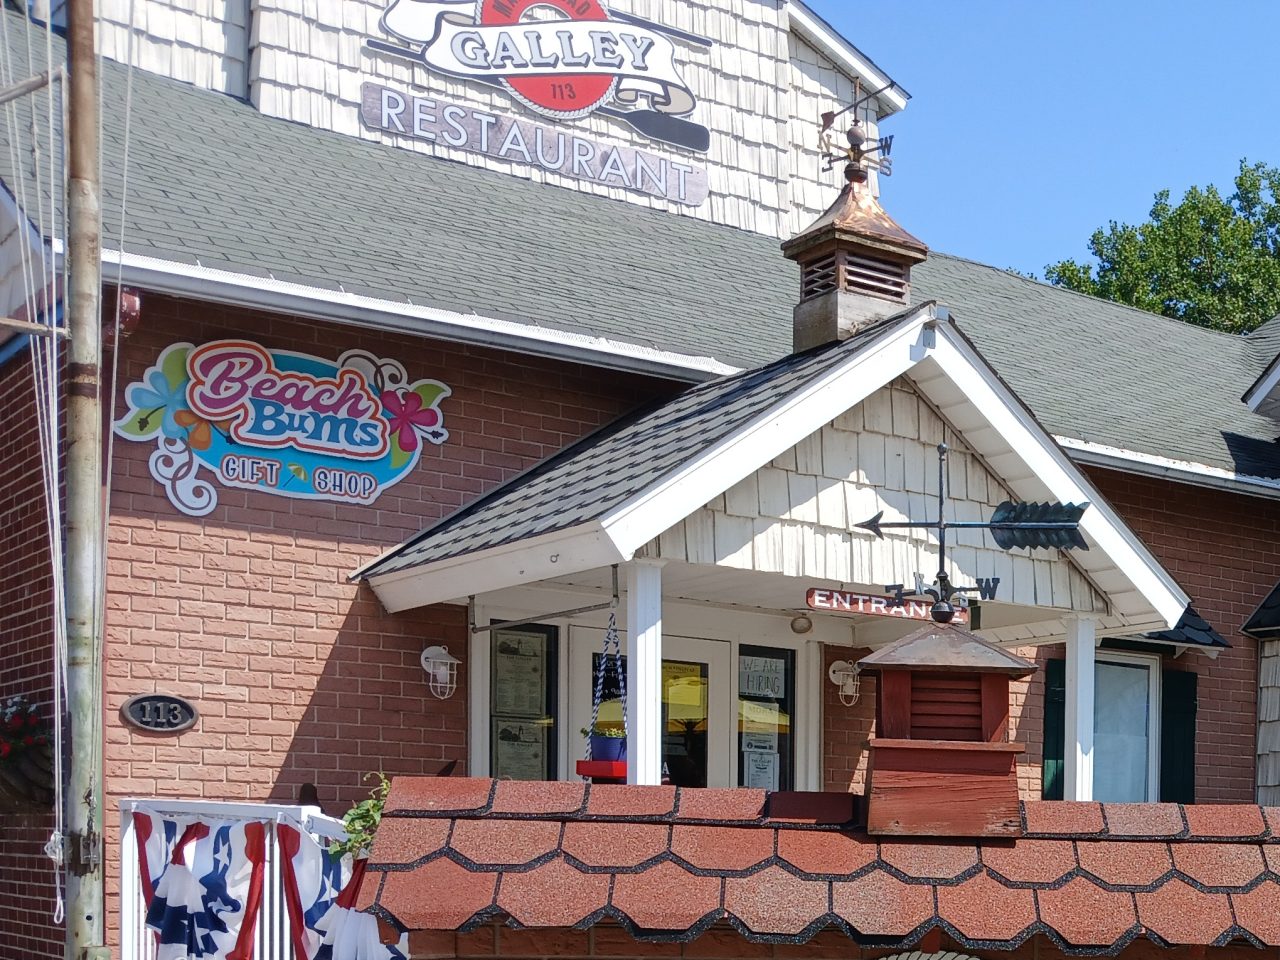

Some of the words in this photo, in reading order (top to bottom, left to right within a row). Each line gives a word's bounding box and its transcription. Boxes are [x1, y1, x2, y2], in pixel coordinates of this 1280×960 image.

[450, 30, 655, 70] GALLEY
[551, 83, 576, 100] 113
[380, 88, 692, 200] RESTAURANT
[199, 351, 374, 419] Beach
[248, 397, 381, 447] Bums
[224, 457, 280, 485] GIFT
[316, 470, 376, 497] SHOP
[814, 589, 964, 622] ENTRANE
[746, 674, 780, 694] HIRING
[141, 701, 182, 724] 113
